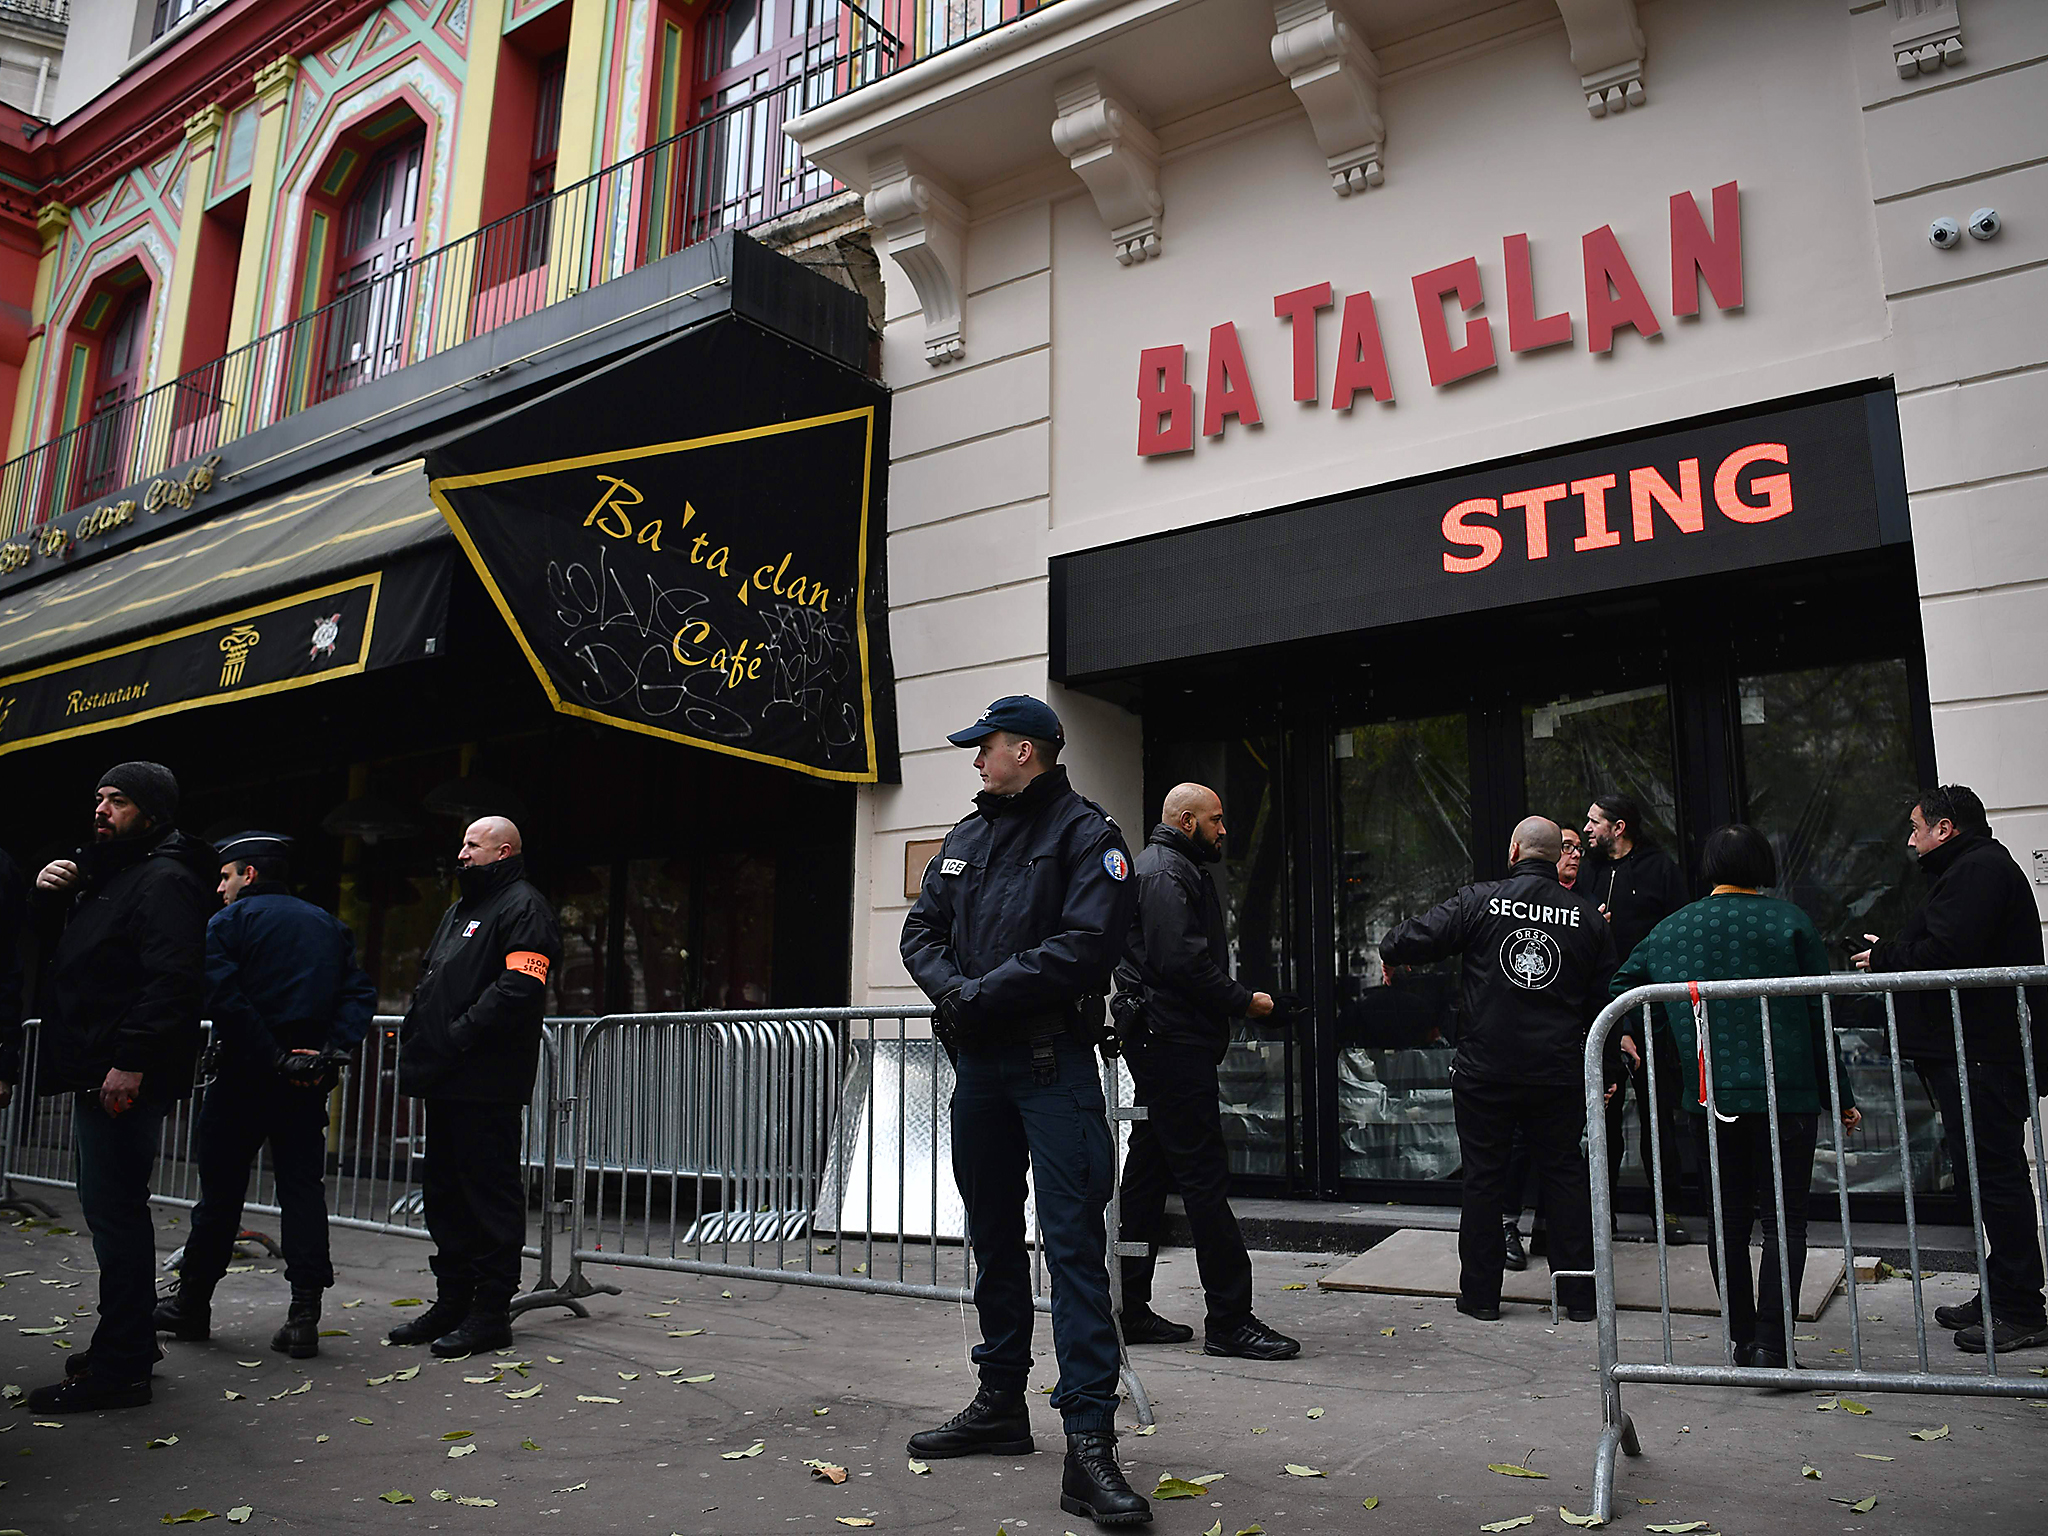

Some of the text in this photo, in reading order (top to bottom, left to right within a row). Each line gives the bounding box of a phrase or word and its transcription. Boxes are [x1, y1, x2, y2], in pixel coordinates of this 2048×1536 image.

[1440, 442, 1794, 574] STING
[672, 621, 766, 689] Café
[65, 681, 150, 716] Restaurant
[942, 861, 964, 873] ICE
[1515, 931, 1548, 943] ORSO
